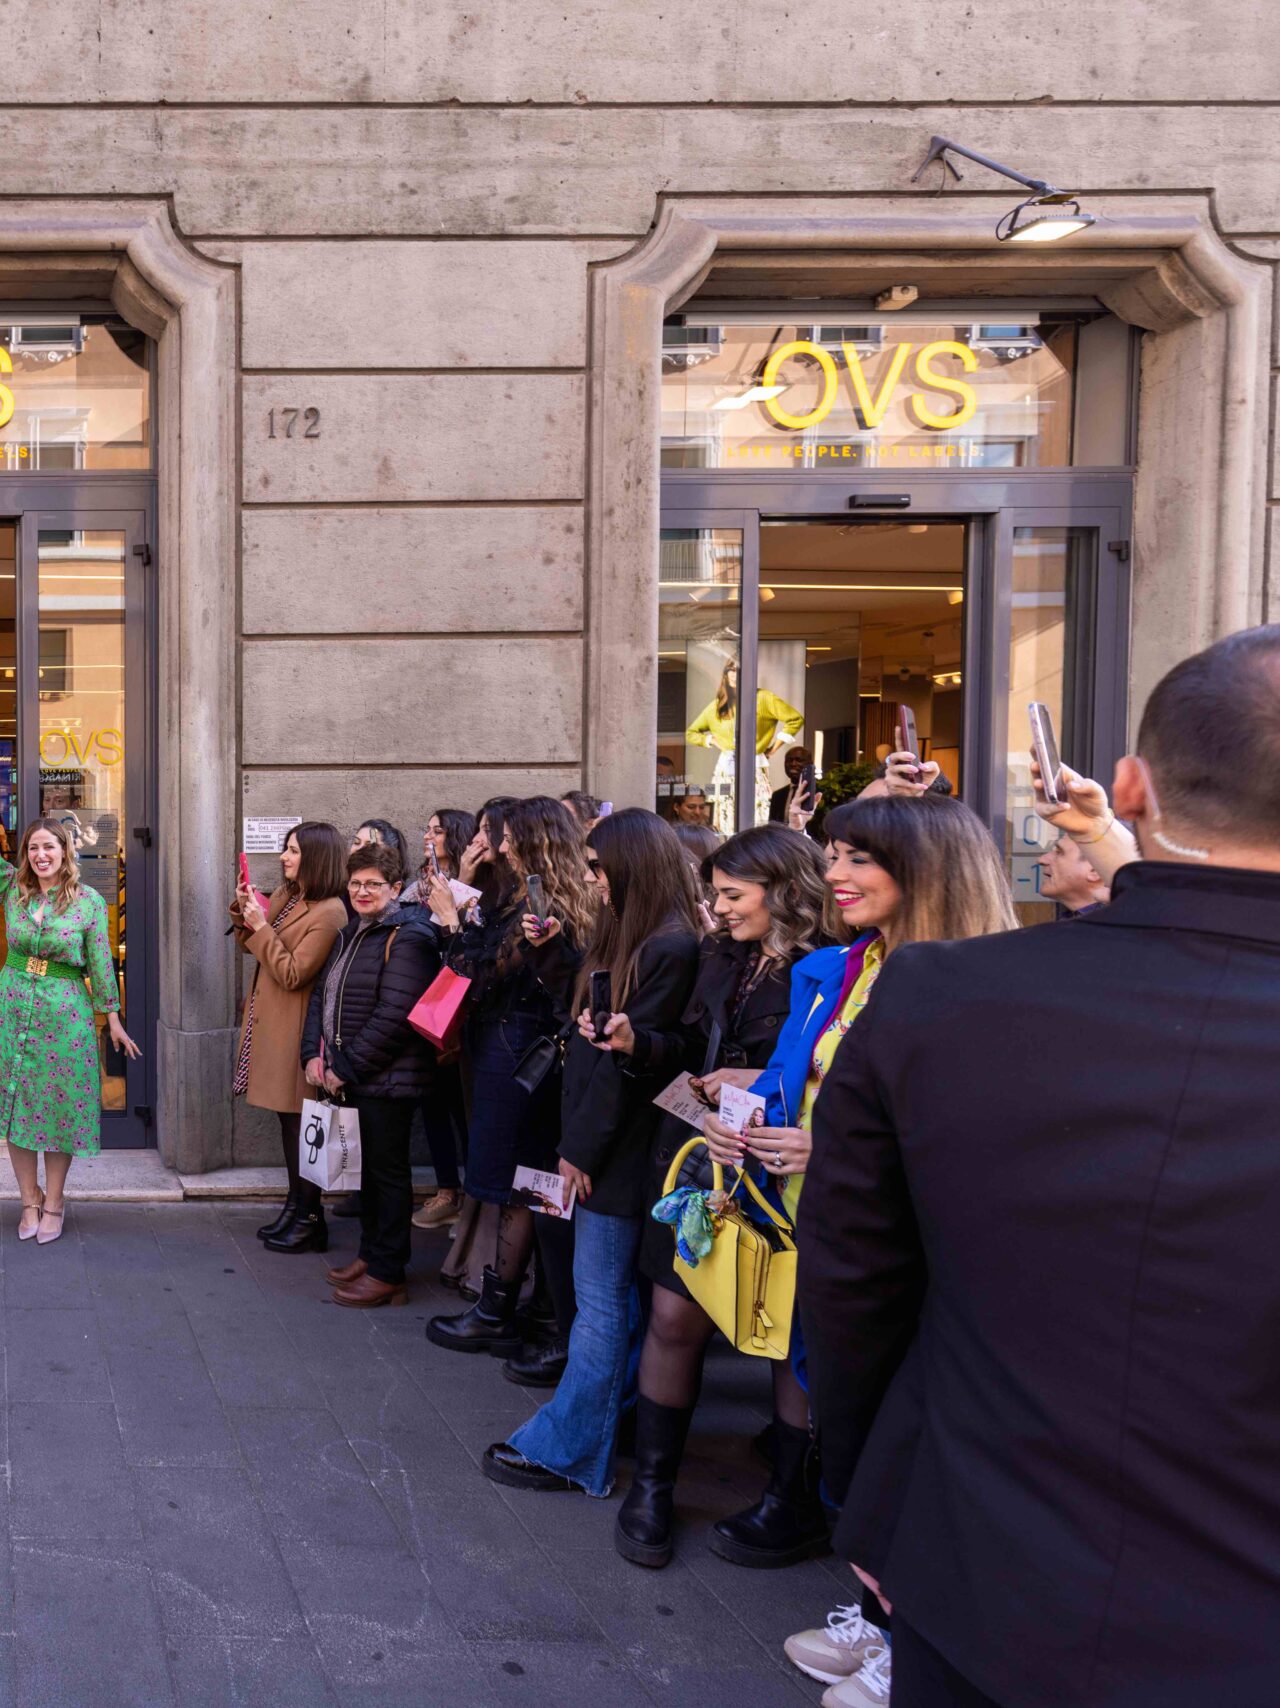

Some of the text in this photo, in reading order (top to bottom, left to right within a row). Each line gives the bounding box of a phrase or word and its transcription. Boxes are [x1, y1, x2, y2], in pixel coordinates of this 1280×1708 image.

[762, 340, 977, 429] OVS
[267, 406, 321, 439] 172
[727, 445, 771, 458] LOVE
[782, 445, 857, 458] PEOPLE.
[908, 444, 984, 458] LABELS.
[38, 727, 124, 766] OVS
[338, 1124, 350, 1170] RINASCENTE
